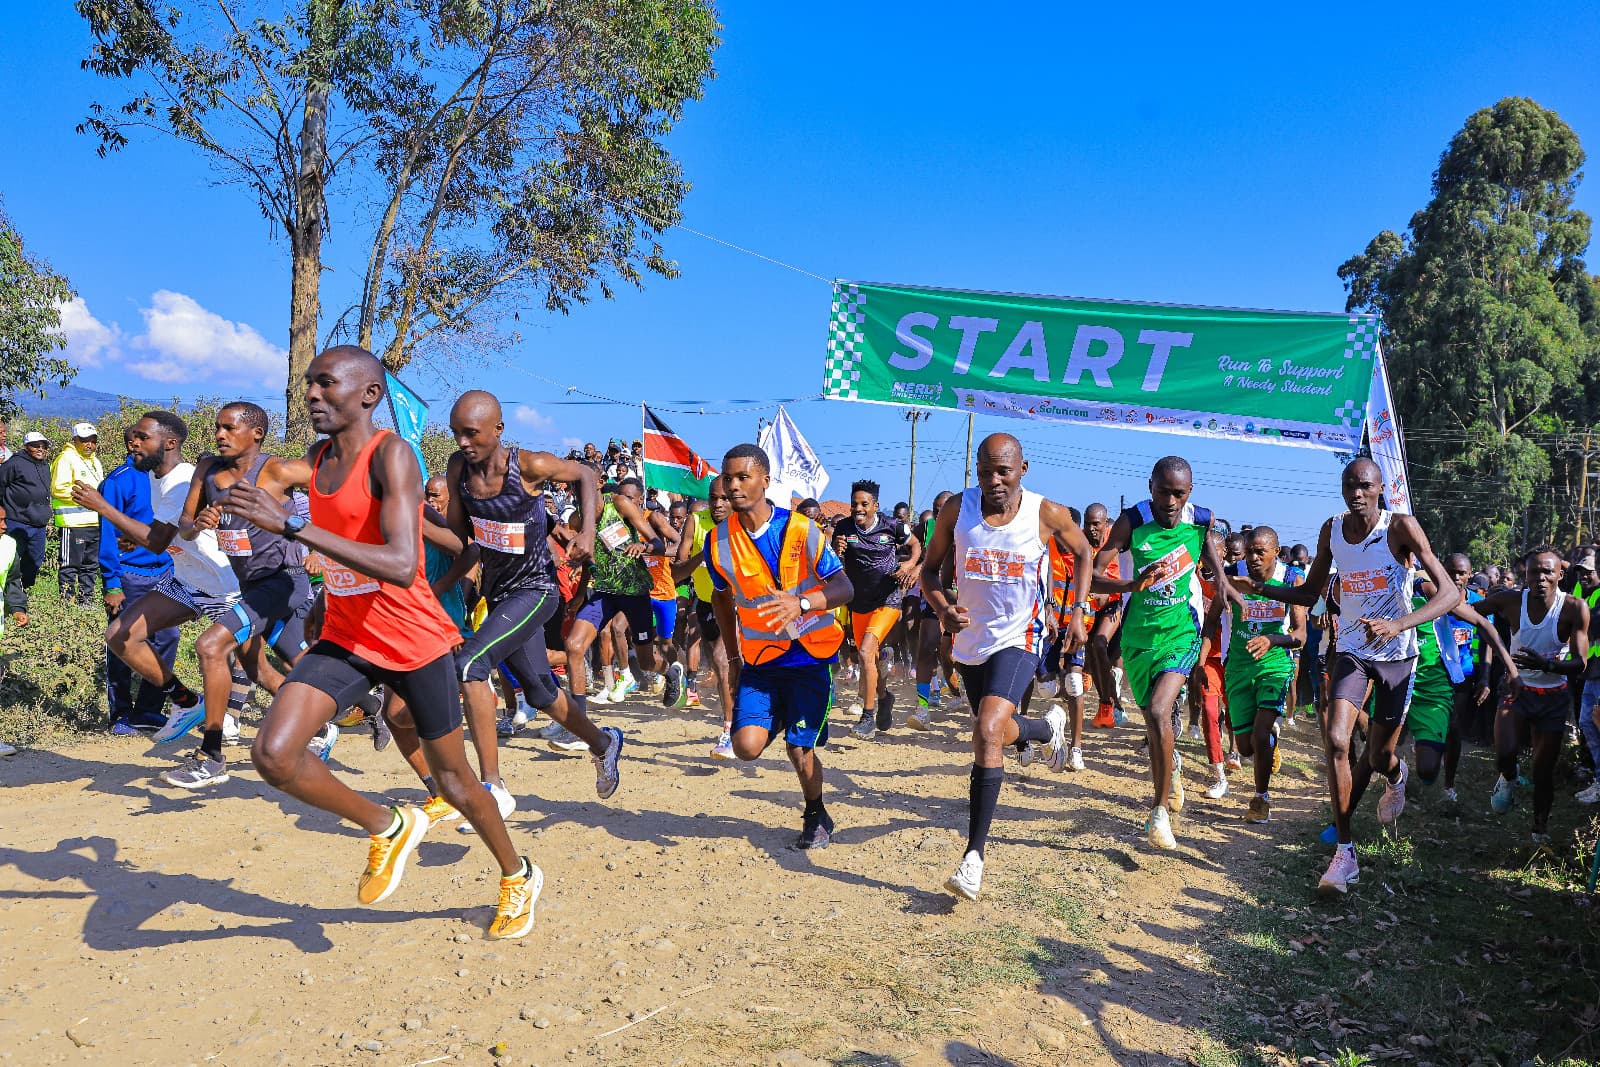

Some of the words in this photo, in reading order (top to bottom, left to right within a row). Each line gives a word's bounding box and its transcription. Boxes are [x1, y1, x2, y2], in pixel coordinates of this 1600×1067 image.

[887, 311, 1194, 392] START
[1217, 355, 1252, 372] Run
[1258, 358, 1273, 374] To
[1278, 360, 1344, 380] Support
[893, 381, 934, 394] MERU
[1223, 375, 1234, 387] A
[1237, 376, 1277, 394] Needy
[1280, 380, 1333, 396] Student
[891, 391, 933, 400] UNIVERSITY
[1039, 404, 1089, 418] Safaricom
[483, 531, 510, 546] 1136
[326, 571, 357, 587] 1129
